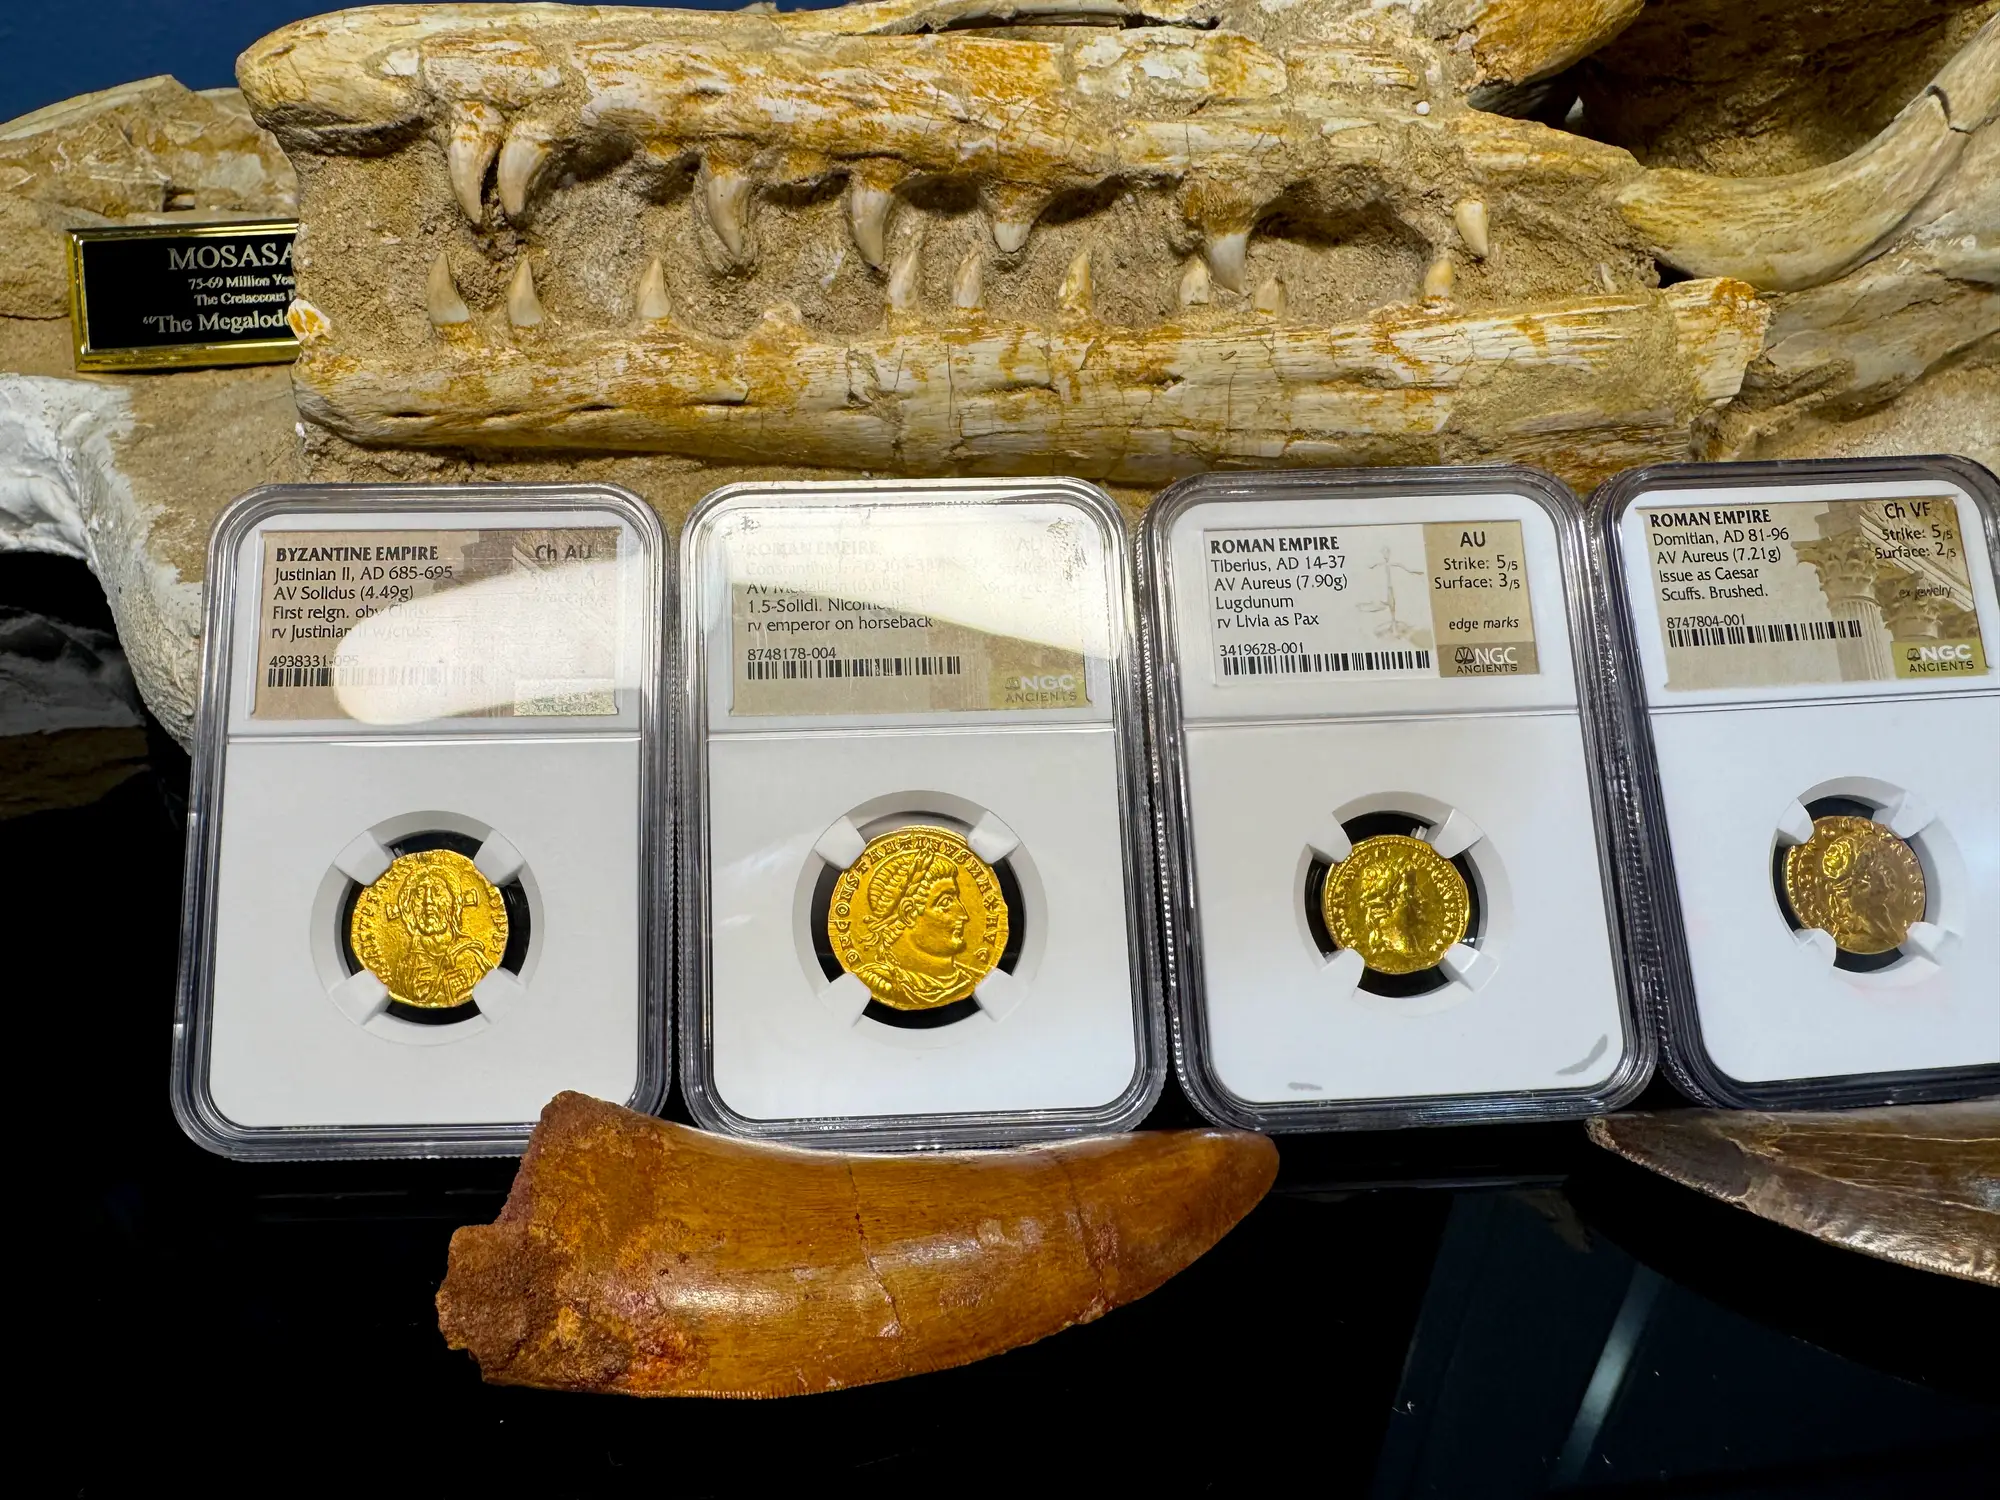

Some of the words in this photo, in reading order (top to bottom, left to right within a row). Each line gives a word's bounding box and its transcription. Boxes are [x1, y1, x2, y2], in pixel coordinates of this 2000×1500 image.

[188, 276, 224, 291] 75-69
[226, 274, 271, 289] Million
[193, 293, 219, 307] The
[220, 291, 286, 305] Cretaceous
[1650, 511, 1711, 528] ROMAN
[1714, 508, 1772, 525] EMPIRE
[1884, 502, 1906, 519] Ch
[1910, 501, 1931, 517] VF
[1459, 531, 1487, 548] AU
[1652, 529, 1719, 547] Domitian,
[1723, 528, 1745, 543] AD
[1748, 527, 1790, 542] 81-96
[1882, 527, 1926, 541] Strike:
[275, 546, 372, 562] BYZANTINE
[375, 545, 439, 561] EMPIRE
[535, 544, 557, 561] Ch
[1210, 536, 1278, 554] ROMAN
[1279, 536, 1340, 551] EMPIRE
[1874, 545, 1930, 560] Surface:
[1210, 557, 1273, 573] Tiberius,
[1276, 556, 1300, 571] AD
[1305, 555, 1346, 570] 14-37
[1443, 557, 1491, 572] Strike:
[1496, 555, 1519, 572] 5/5
[1656, 550, 1678, 565] AV
[1681, 549, 1729, 564] Aureus
[1733, 546, 1782, 564] (7.21g)
[274, 566, 337, 584] Justinian
[341, 566, 356, 583] II,
[360, 566, 385, 580] AD
[389, 565, 453, 580] 685-695
[1214, 577, 1237, 591] AV
[1241, 576, 1292, 591] Aureus
[1296, 573, 1348, 591] (7.90g)
[1434, 575, 1493, 591] Surface:
[1498, 572, 1521, 591] 3/5
[1697, 570, 1711, 582] as
[1714, 566, 1760, 582] Caesar
[273, 586, 297, 600] AV
[300, 585, 356, 600] Solidus
[360, 584, 414, 603] (4.49g)
[1661, 586, 1706, 602] Scuffs.
[1709, 583, 1769, 600] Brushed.
[1899, 588, 1912, 599] ex
[1914, 584, 1952, 600] jewelry
[1215, 595, 1295, 613] Lugdunum
[272, 606, 304, 620] First
[307, 605, 350, 623] reign.
[355, 605, 380, 619] obv
[1217, 618, 1231, 629] rv
[1236, 614, 1269, 628] Livia
[1274, 615, 1290, 627] as
[1294, 612, 1320, 627] Pax
[1666, 613, 1746, 629] 8747804-001
[748, 622, 761, 634] rv
[766, 618, 831, 635] emperor
[834, 619, 854, 631] on
[858, 615, 933, 632] horseback
[1449, 617, 1480, 632] edge
[1483, 616, 1520, 630] marks
[271, 627, 287, 639] rv
[747, 646, 838, 661] 8748178-004
[1219, 641, 1305, 657] 3419628-001
[1475, 646, 1519, 665] NGC
[1920, 643, 1973, 660] NGC
[1456, 663, 1519, 674] ANCIENTS
[1909, 659, 1975, 674] ANCIENTS
[1020, 674, 1076, 690] NGC
[1005, 691, 1077, 704] ANCIENTS
